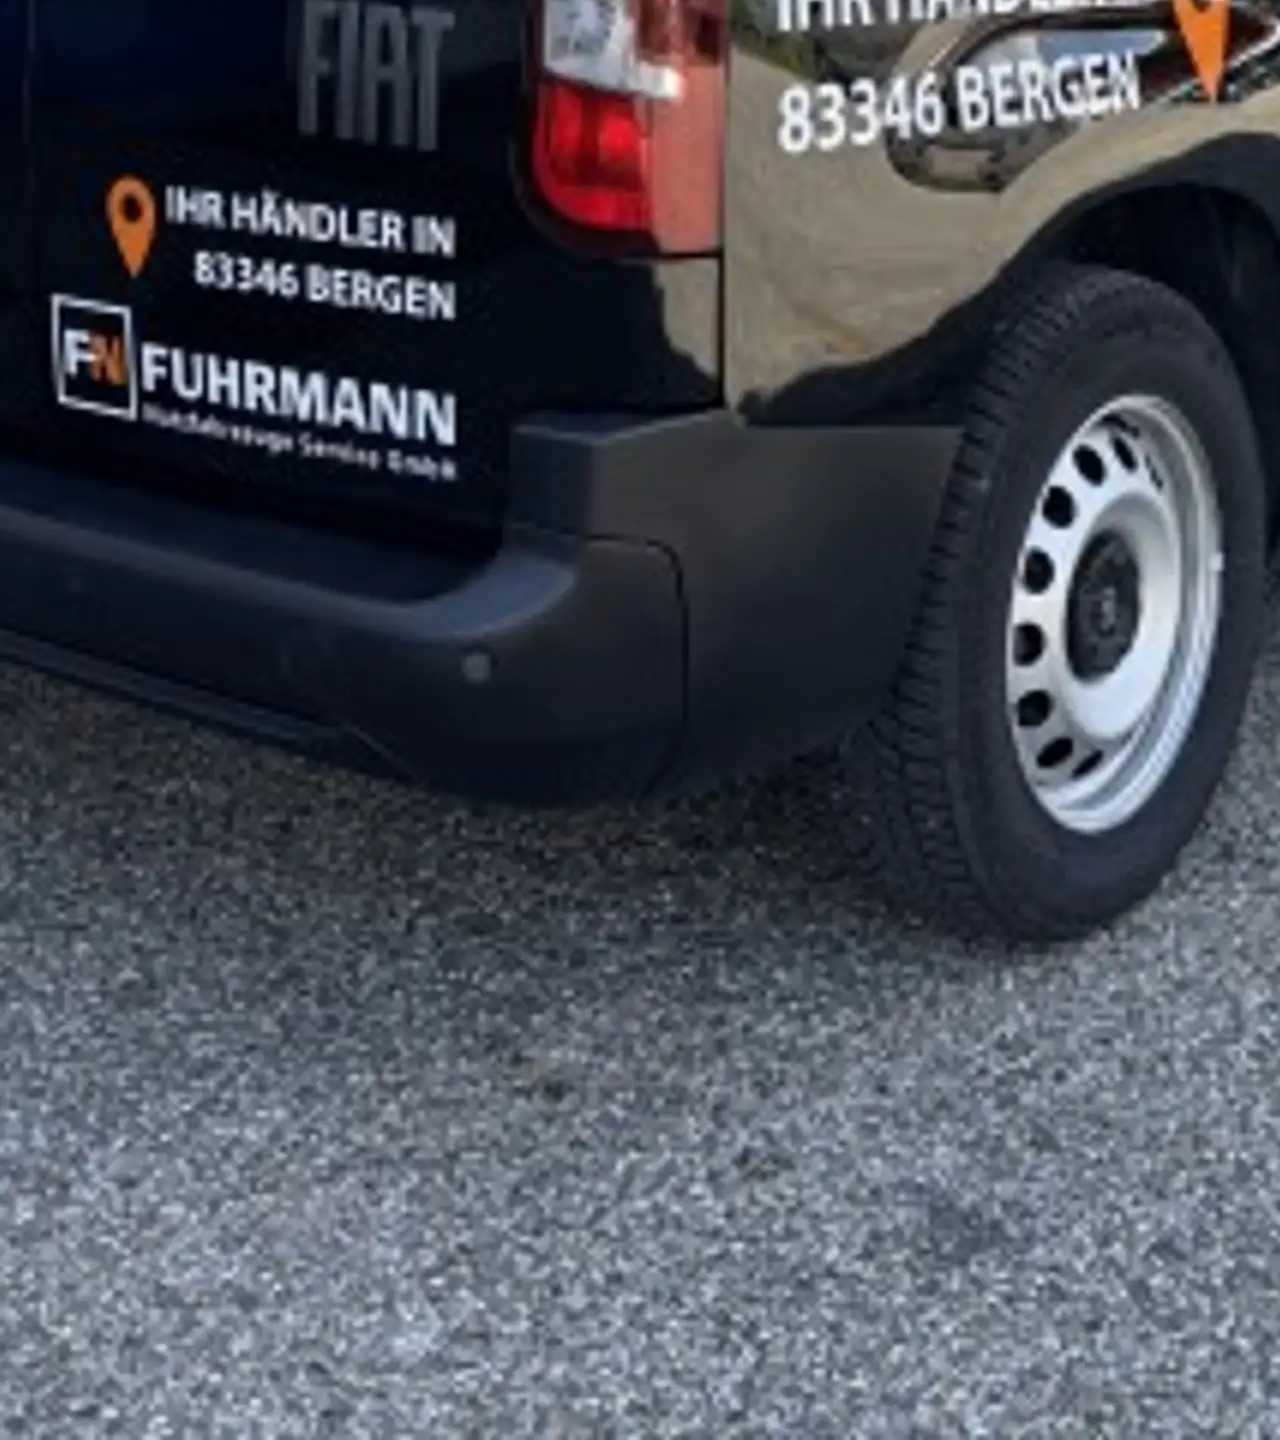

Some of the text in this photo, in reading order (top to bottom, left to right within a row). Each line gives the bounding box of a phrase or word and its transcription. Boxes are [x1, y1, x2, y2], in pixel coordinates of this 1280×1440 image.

[776, 51, 1142, 154] 83346 BERGEN
[164, 185, 456, 258] IHR HÄNDLER IN
[193, 250, 456, 321] 83346 BERGEN
[63, 328, 128, 386] FN
[141, 342, 456, 446] FUHRMANN
